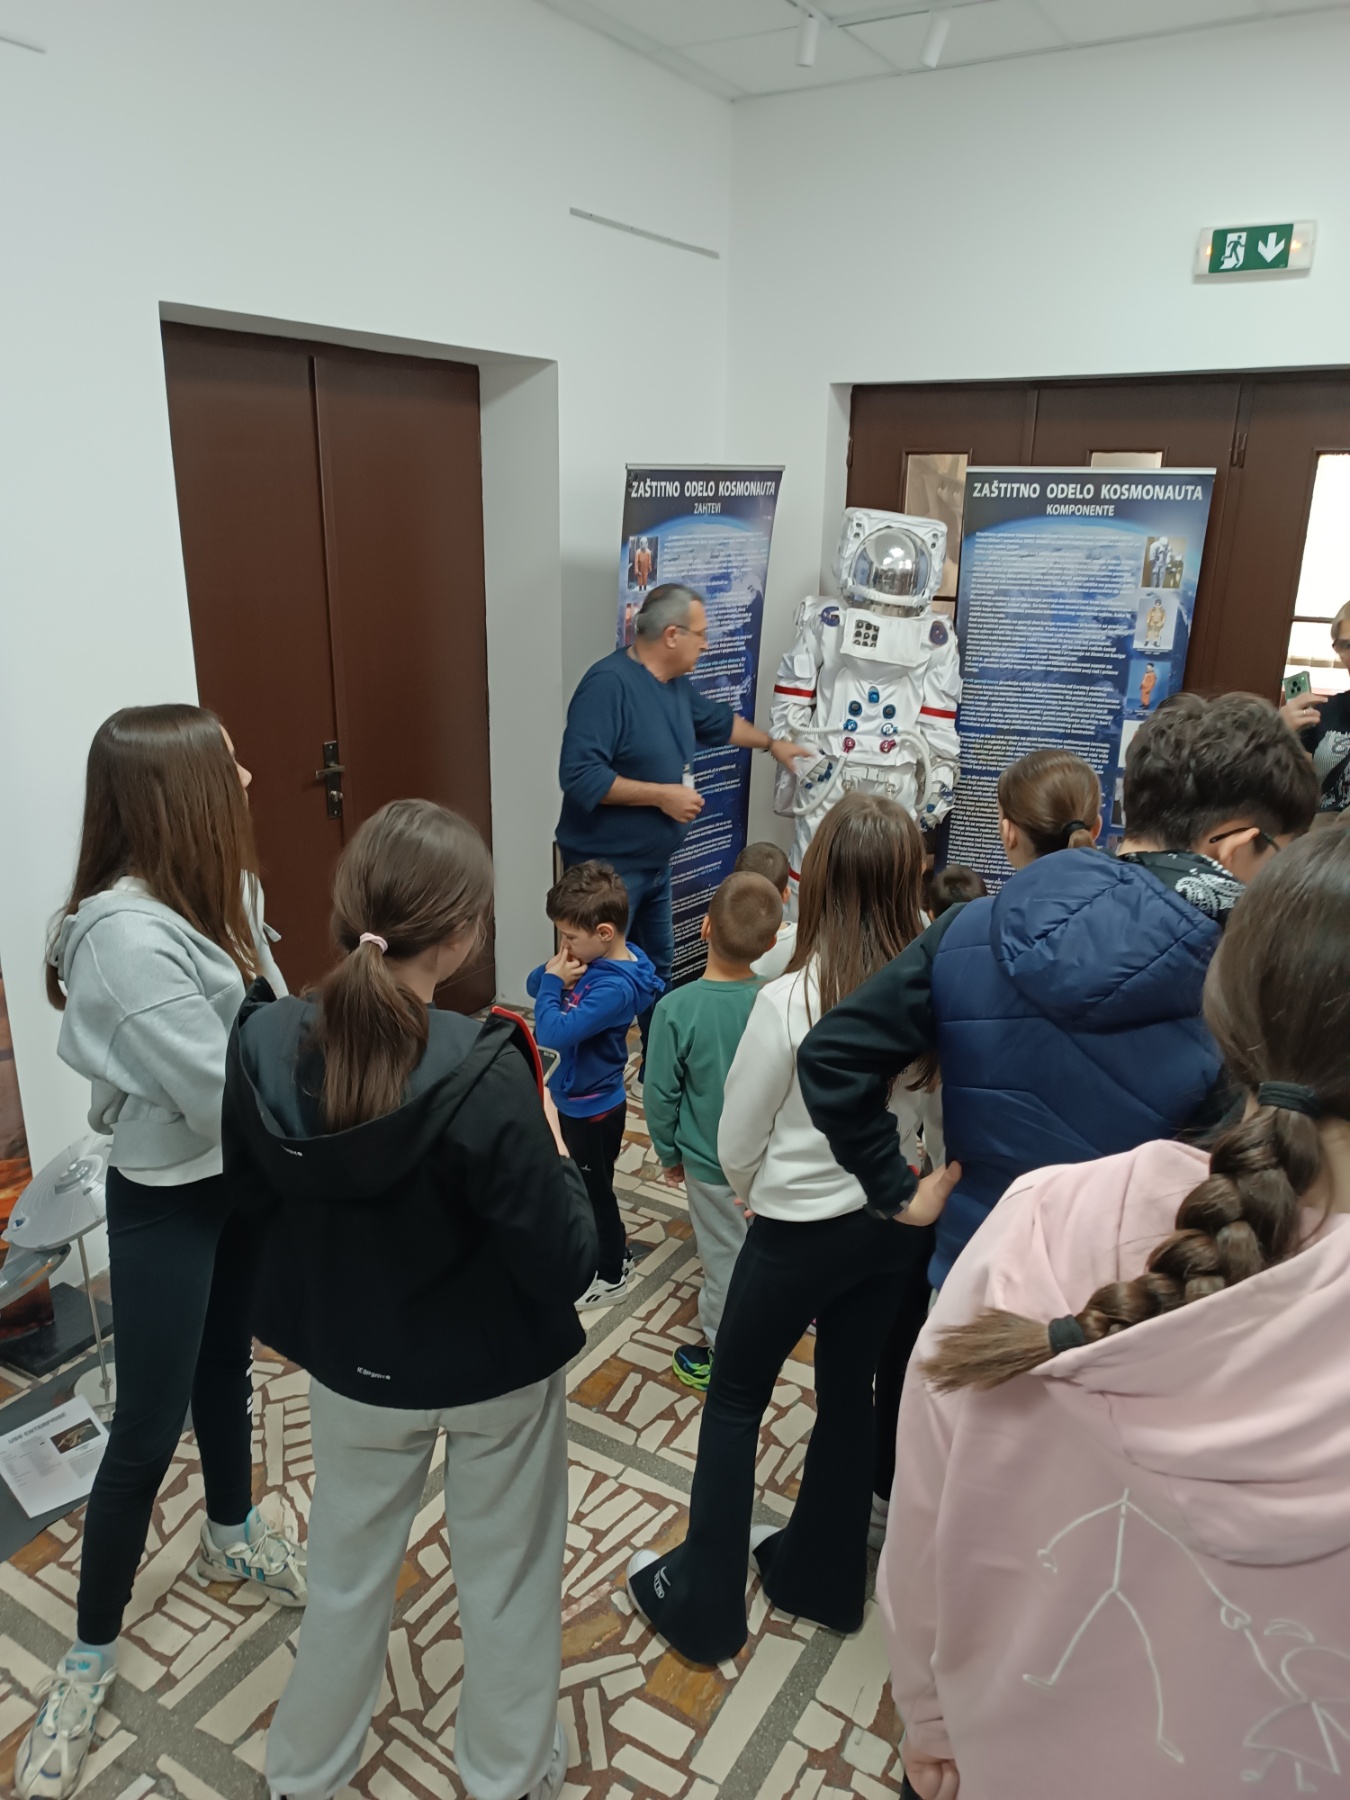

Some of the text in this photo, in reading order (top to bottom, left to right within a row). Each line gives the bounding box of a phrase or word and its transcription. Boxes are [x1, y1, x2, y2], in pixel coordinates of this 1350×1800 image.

[631, 478, 775, 498] ZAŠTITNO ODELO KOSMONAUTA
[973, 480, 1203, 501] ZAŠTITNO ODELO KOSMONAUTA
[693, 502, 721, 515] ZAHTEVI
[1046, 504, 1115, 517] KOMPONENTE
